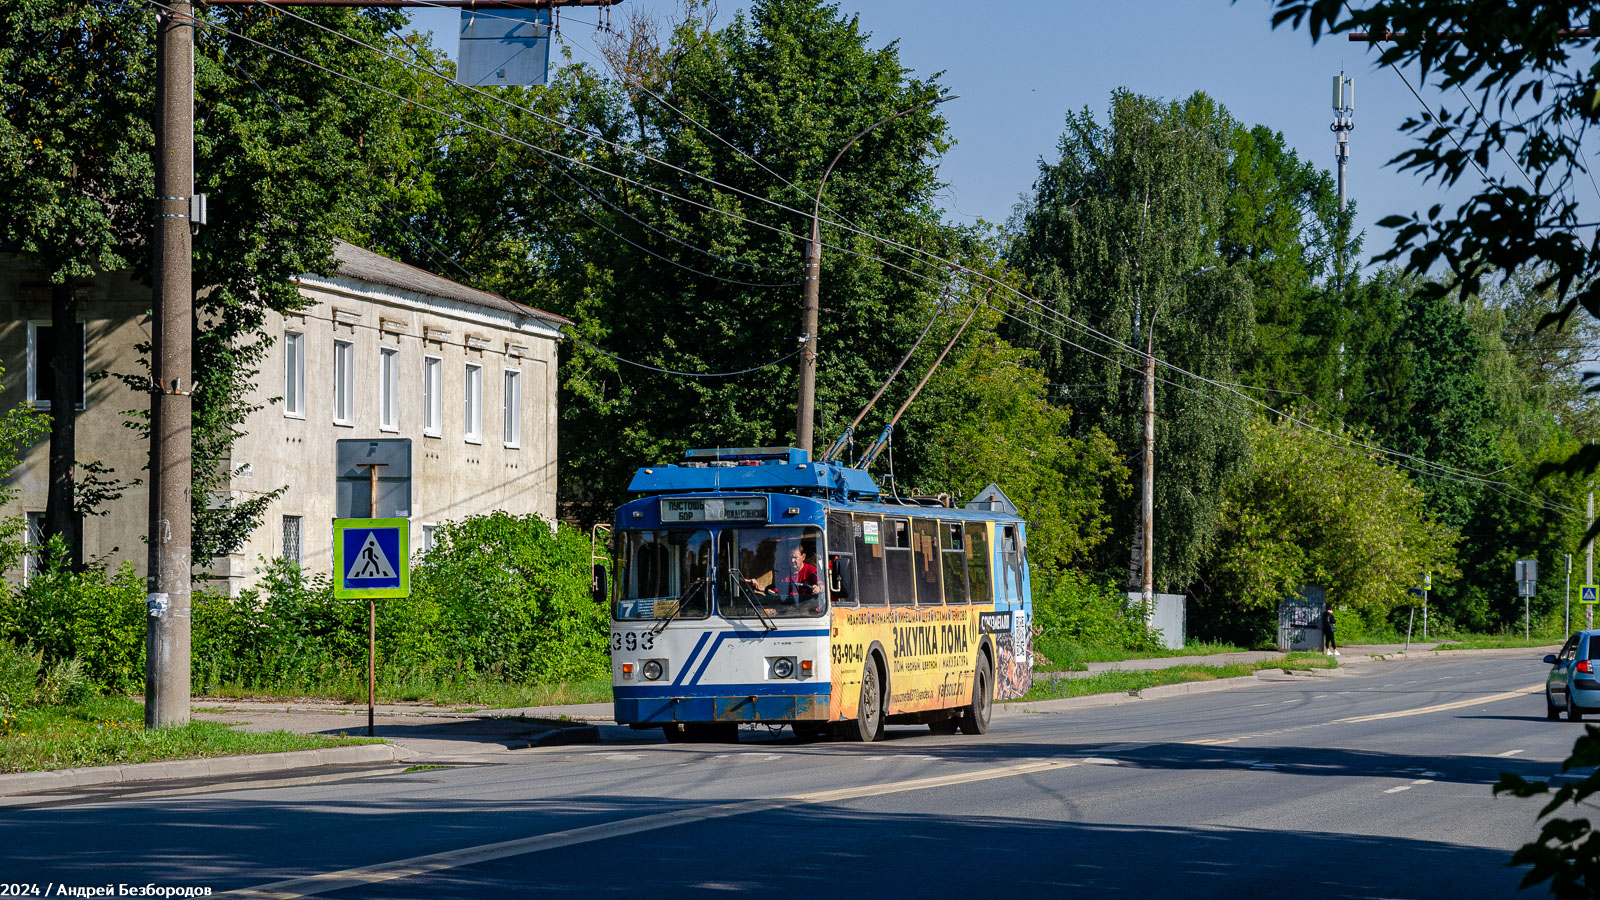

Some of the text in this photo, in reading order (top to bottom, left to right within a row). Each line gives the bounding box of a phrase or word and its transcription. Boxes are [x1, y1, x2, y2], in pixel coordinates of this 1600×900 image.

[669, 501, 704, 511] ПУСТОШЬ
[679, 512, 693, 520] БОР
[622, 603, 634, 618] 7
[612, 632, 654, 651] 393
[893, 624, 968, 658] ЗАКУПКА ЛОМА
[832, 643, 863, 664] 93-90-40
